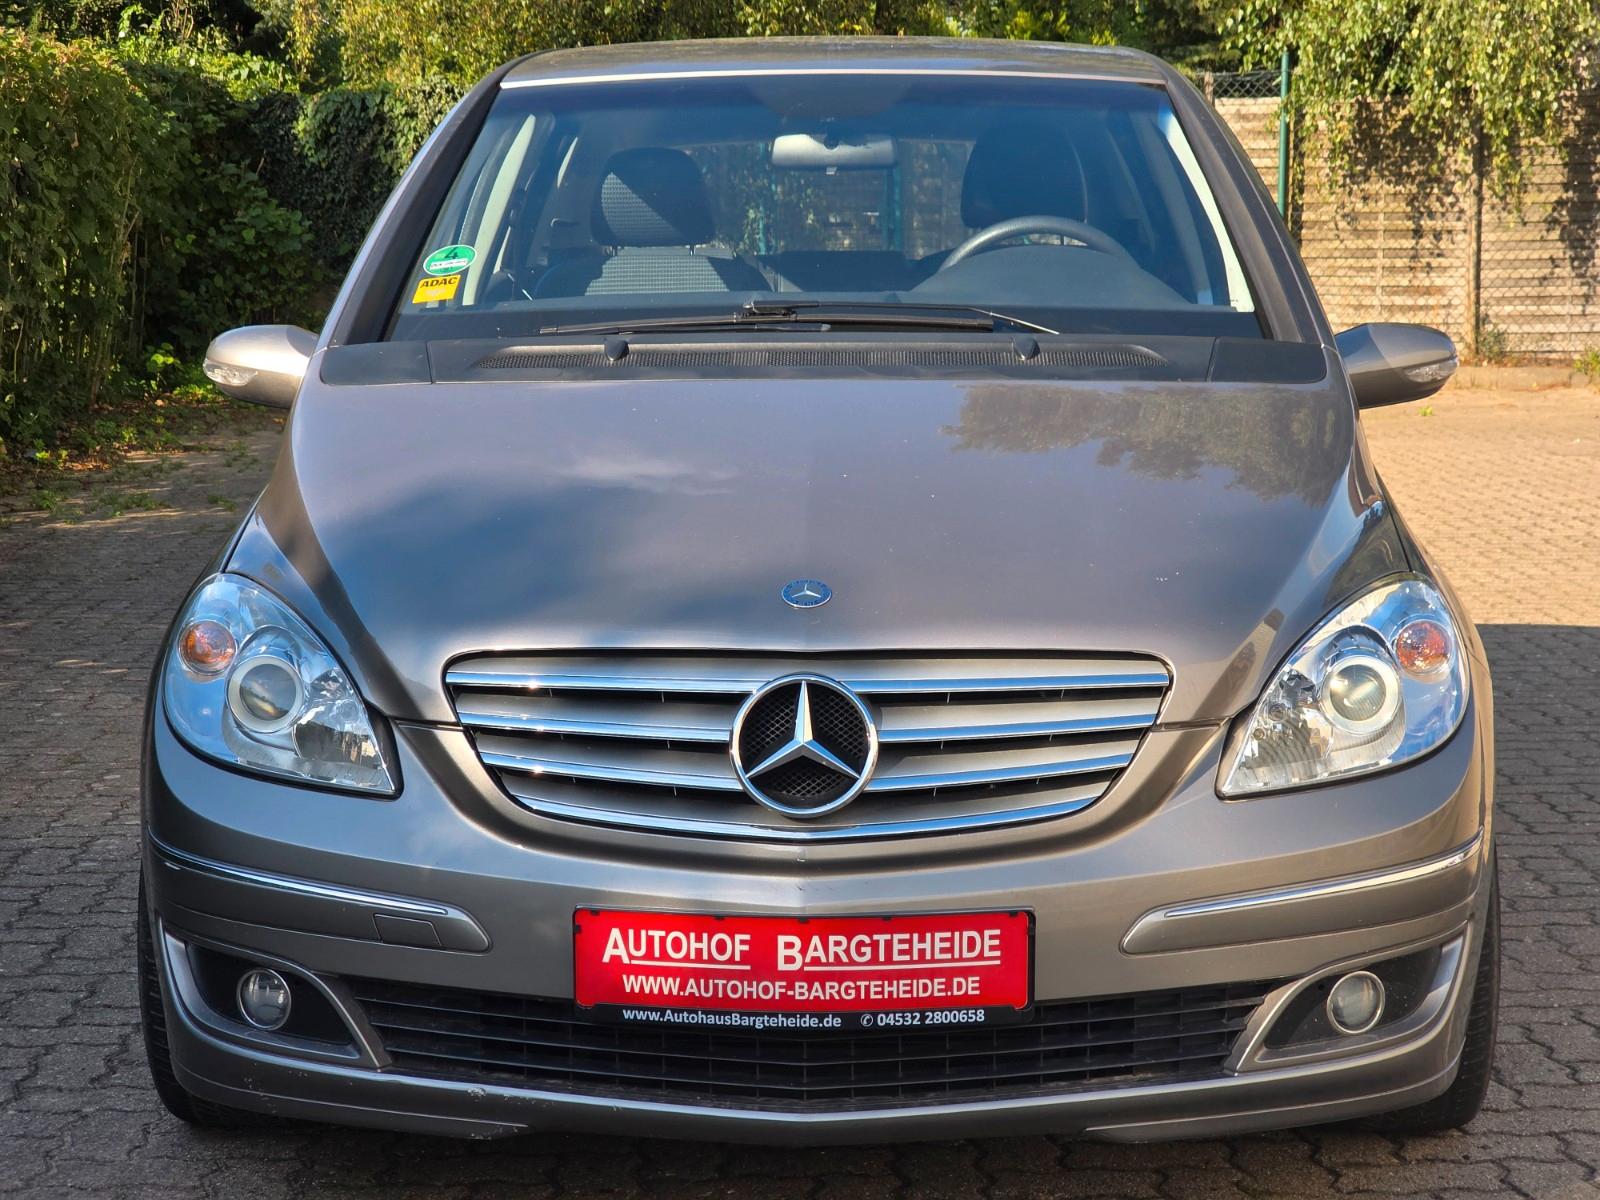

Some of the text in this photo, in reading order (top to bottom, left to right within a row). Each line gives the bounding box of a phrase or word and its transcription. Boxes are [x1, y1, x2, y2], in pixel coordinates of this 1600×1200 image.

[420, 277, 458, 288] ADAC
[602, 927, 1001, 971] AUTOHOF BARGTEHEIDE
[622, 974, 981, 1001] WWW.AUTOHOF-BARGTEHEIDE.DE
[622, 1009, 985, 1030] www.AutohausBargteheide.de 04532 2800658
